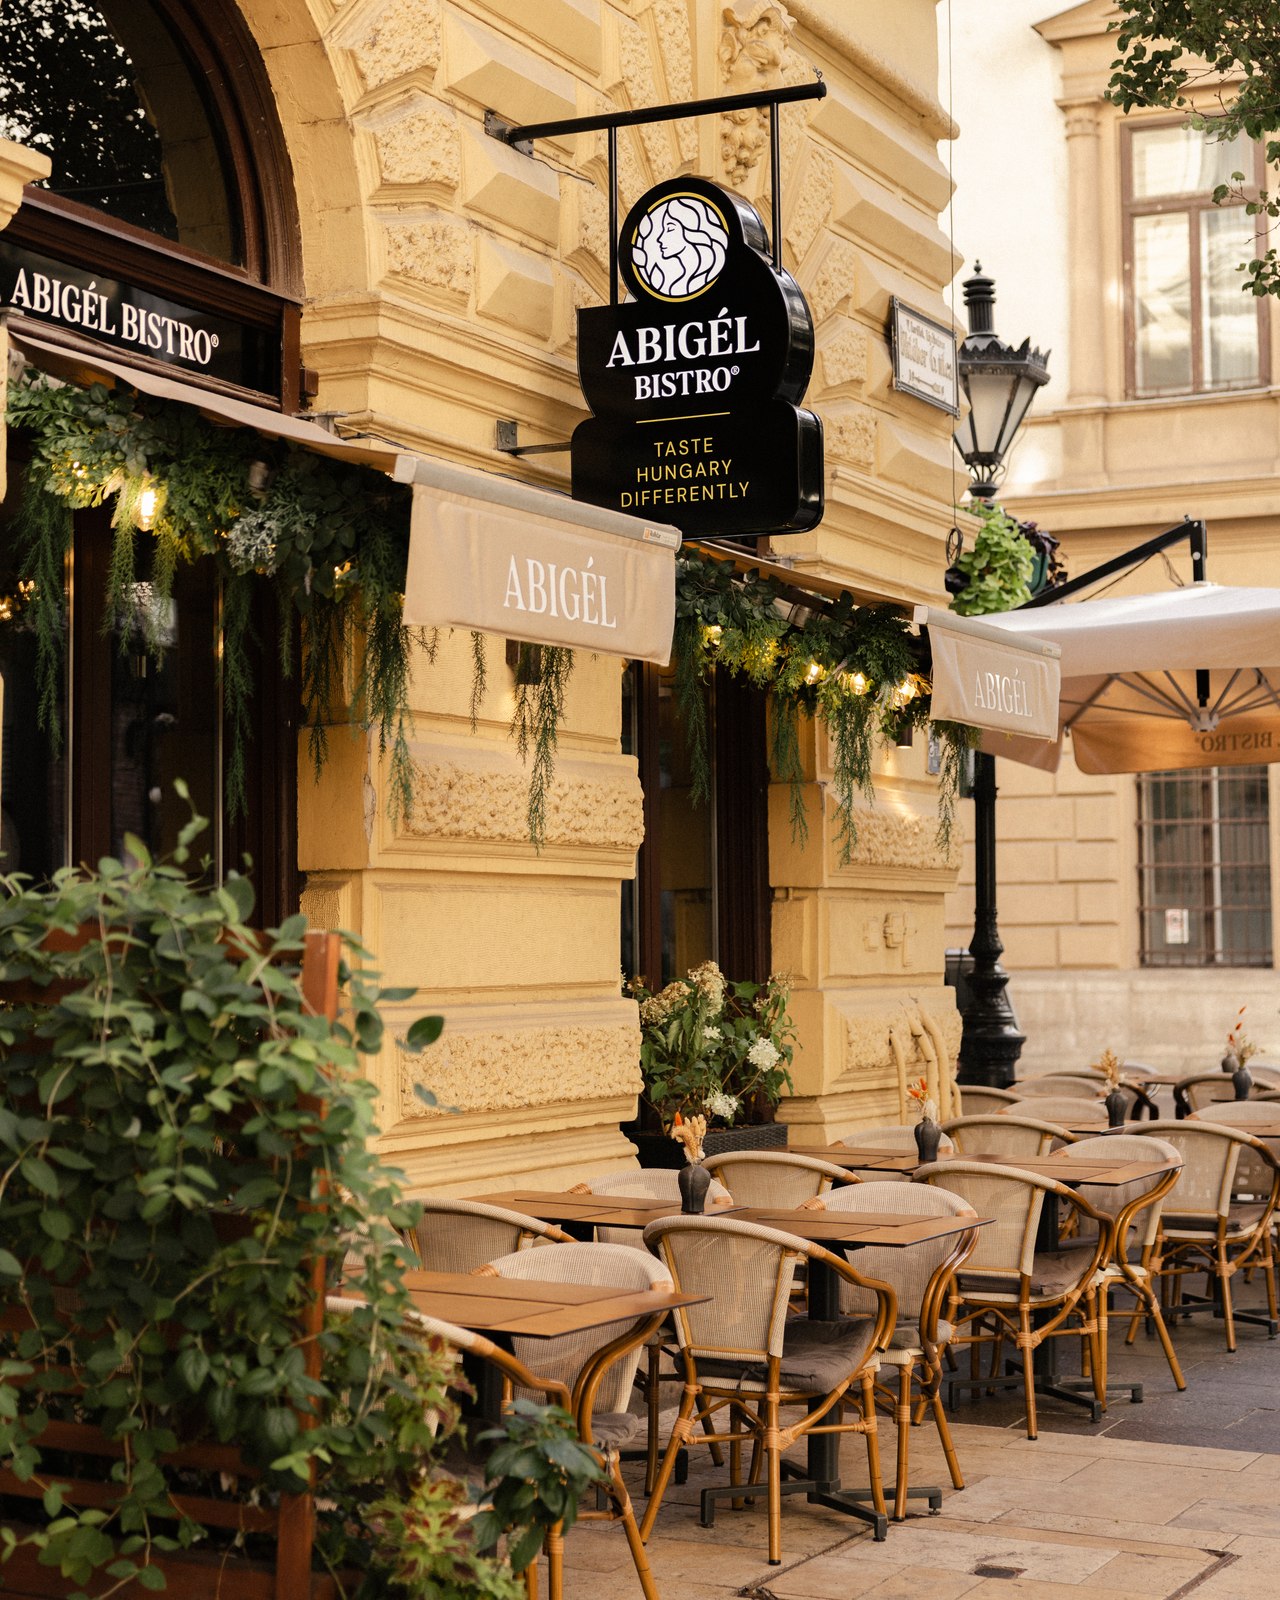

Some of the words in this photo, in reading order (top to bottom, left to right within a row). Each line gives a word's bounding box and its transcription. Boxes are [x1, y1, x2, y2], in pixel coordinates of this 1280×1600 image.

[10, 268, 116, 335] ABIGÉL
[606, 307, 760, 368] ABIGÉL
[637, 459, 732, 482] HUNGARY
[654, 437, 713, 457] TASTE
[621, 481, 749, 507] DIFFERENTLY
[503, 554, 617, 629] ABIGÉL
[974, 668, 1033, 718] ABIGÉL
